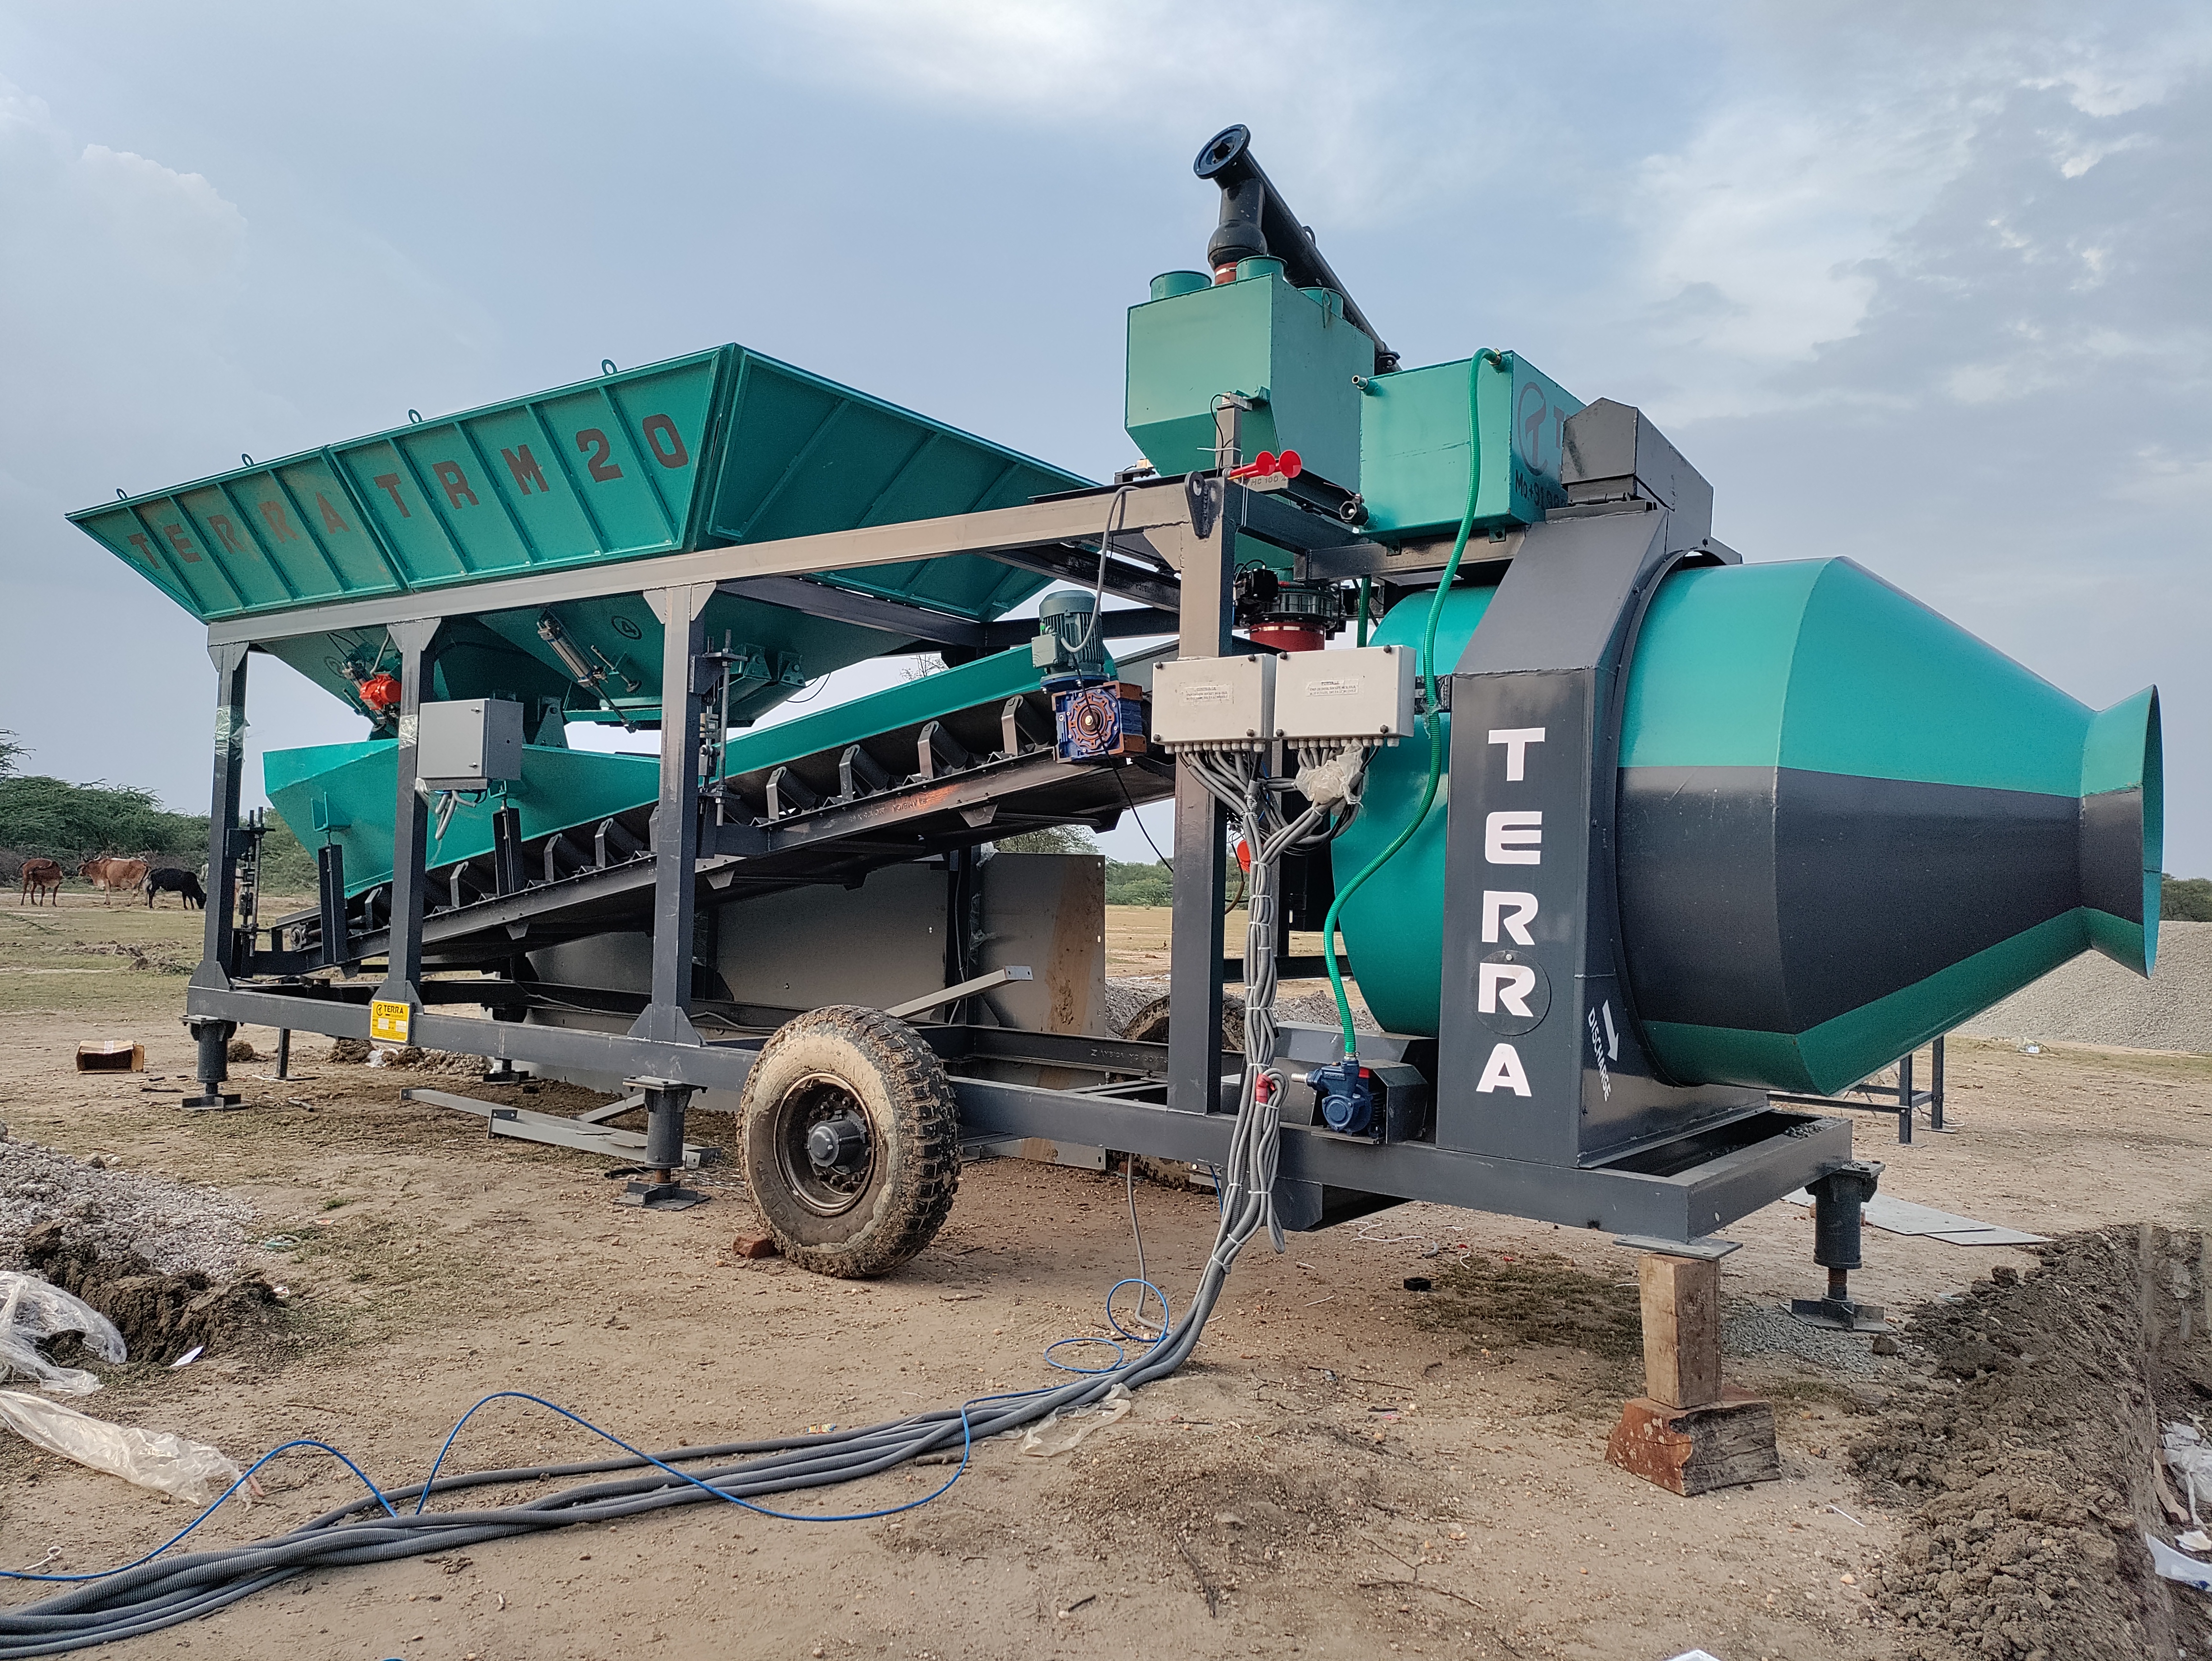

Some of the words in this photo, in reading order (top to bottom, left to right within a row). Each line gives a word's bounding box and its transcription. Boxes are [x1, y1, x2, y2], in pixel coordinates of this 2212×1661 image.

[1265, 475, 1278, 484] 100
[128, 491, 351, 570] TERRA
[1475, 727, 1546, 1097] TERRA
[384, 1005, 404, 1014] TERRA
[1588, 1007, 1611, 1102] DISCHARGE
